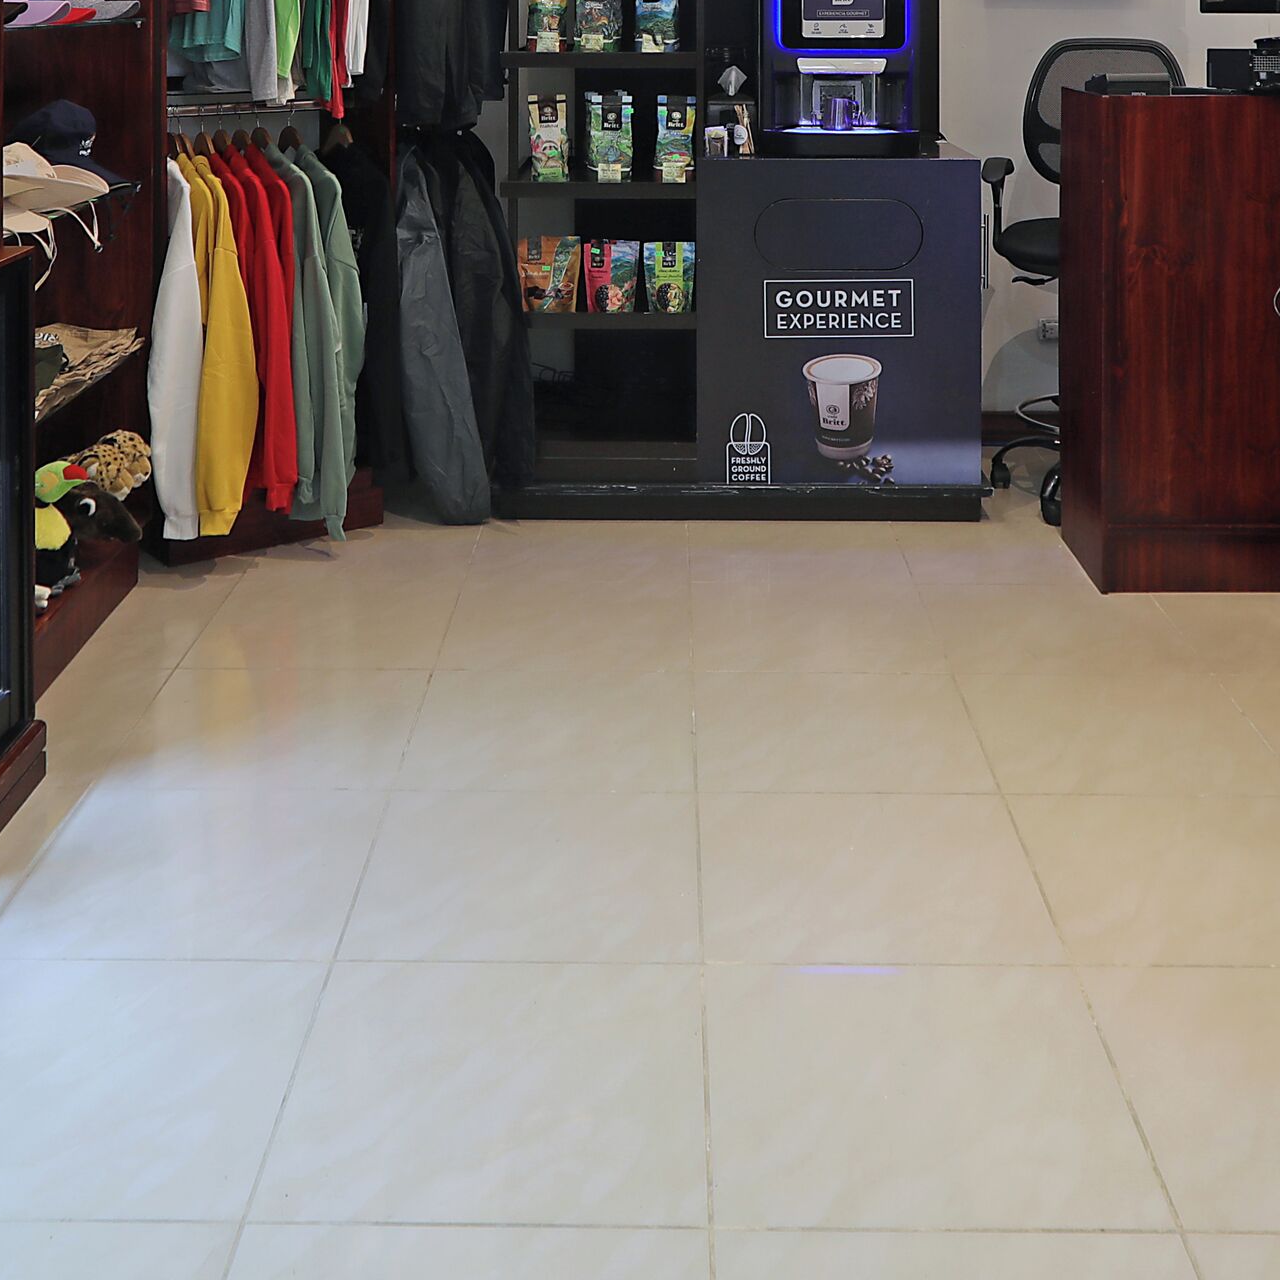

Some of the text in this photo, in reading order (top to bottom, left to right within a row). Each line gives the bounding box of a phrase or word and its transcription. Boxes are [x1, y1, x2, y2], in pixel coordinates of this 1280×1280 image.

[775, 290, 902, 308] GOURMET
[776, 312, 902, 329] EXPERIENCE
[822, 417, 847, 426] Britt
[731, 457, 767, 465] FRESHLY
[731, 465, 767, 473] GROUND
[731, 473, 767, 482] COFFEE
